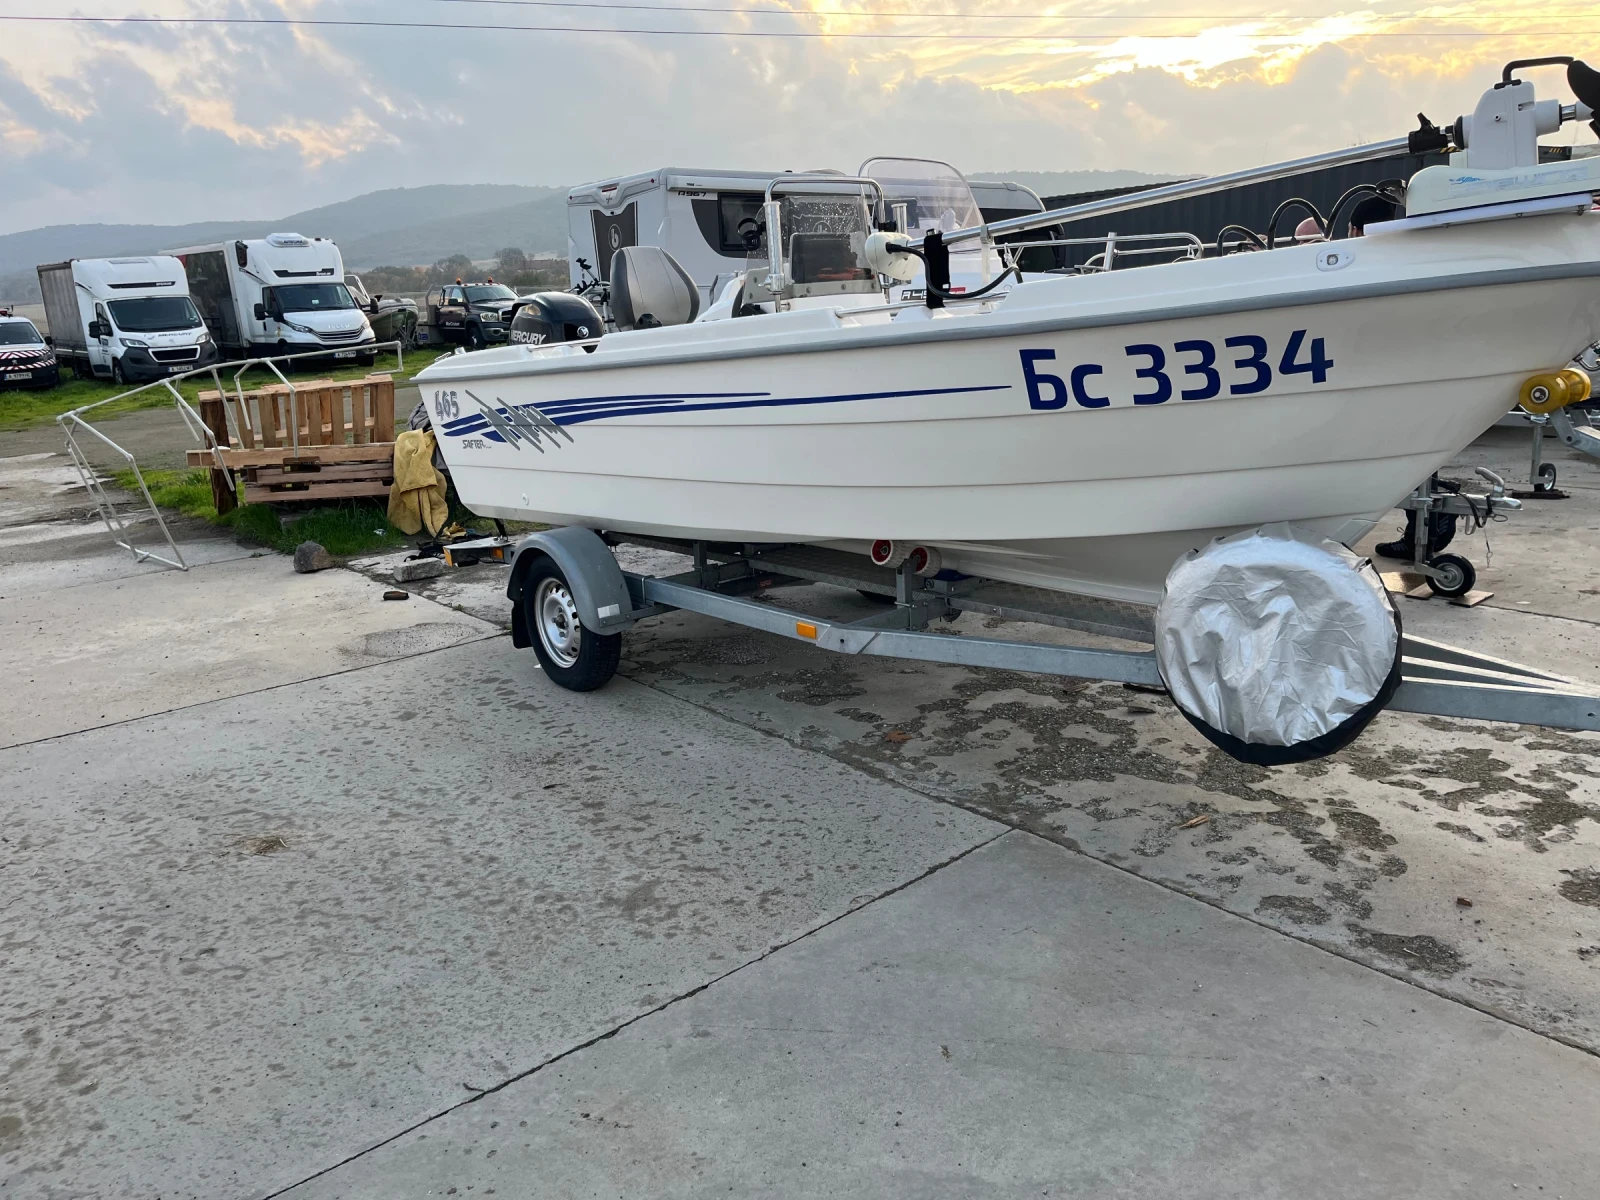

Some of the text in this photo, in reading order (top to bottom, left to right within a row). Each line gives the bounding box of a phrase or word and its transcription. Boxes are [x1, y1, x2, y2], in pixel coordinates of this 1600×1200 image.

[1019, 329, 1334, 411] Бс 3334
[435, 390, 460, 421] 465
